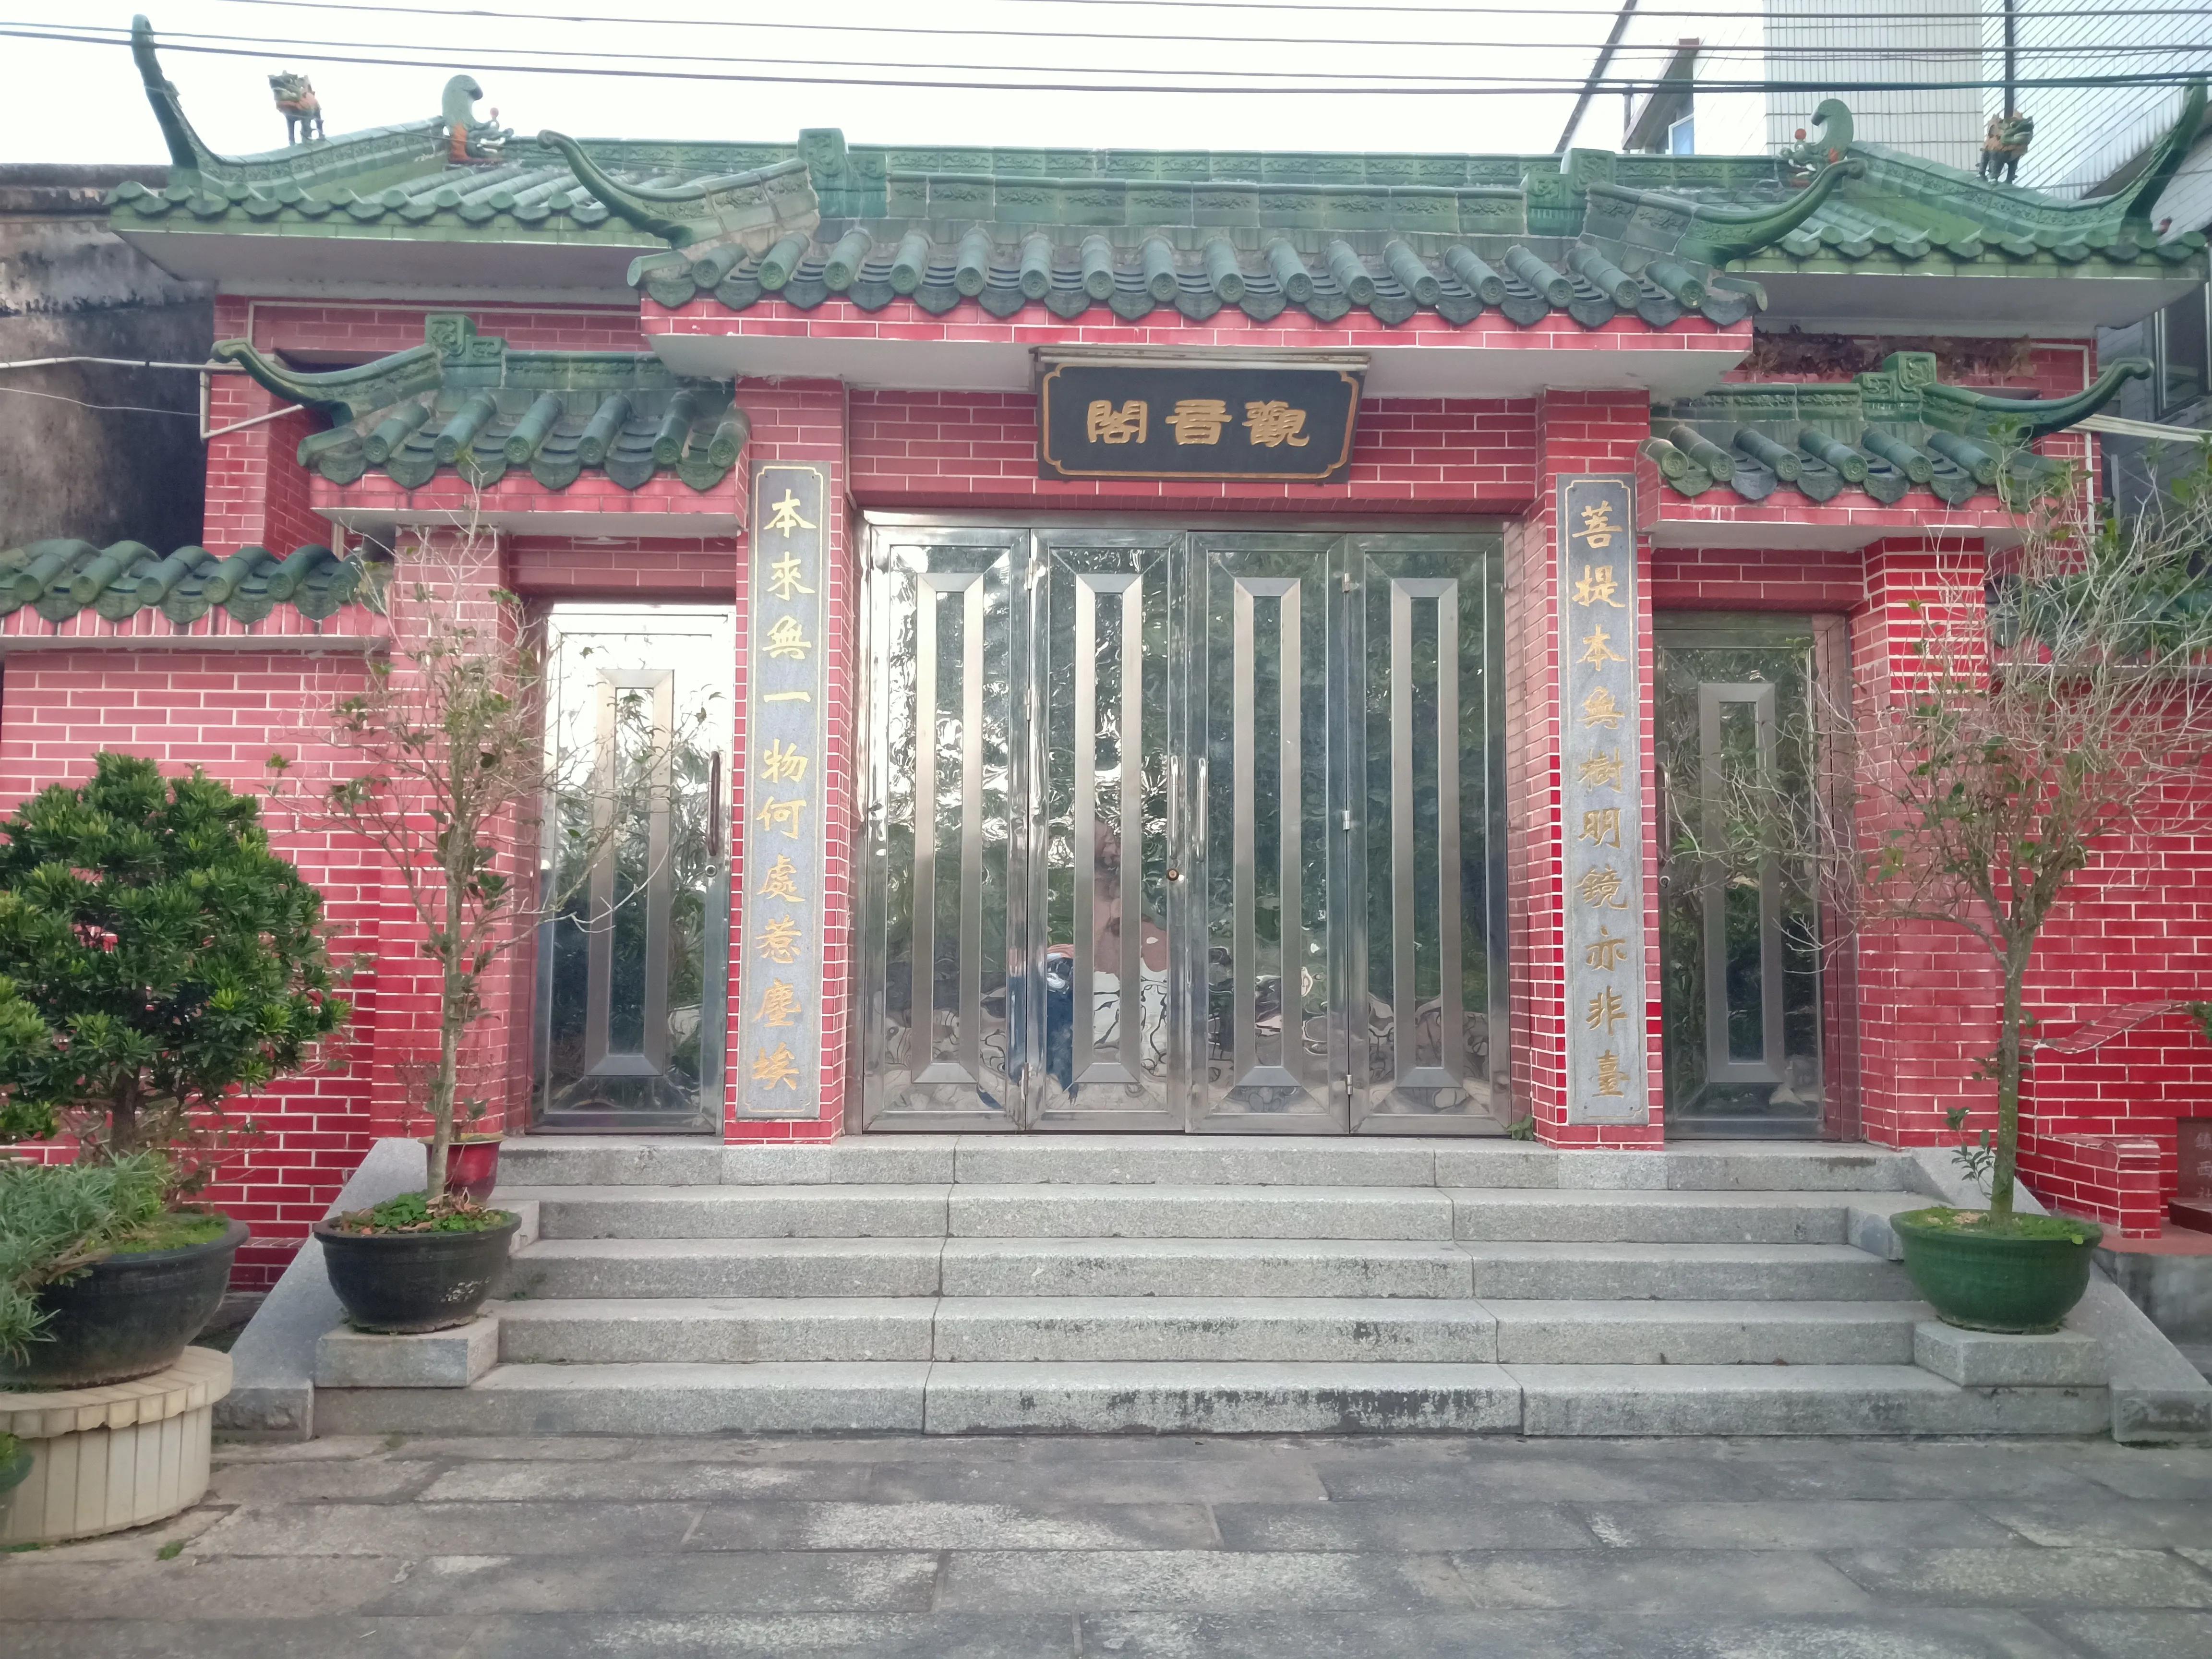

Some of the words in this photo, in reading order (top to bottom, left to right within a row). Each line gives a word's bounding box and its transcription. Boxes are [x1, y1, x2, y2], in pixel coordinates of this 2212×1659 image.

[751, 489, 817, 1091] 本來無一物何處惹塵埃
[1572, 500, 1629, 1097] 菩提本無樹明鏡亦非臺
